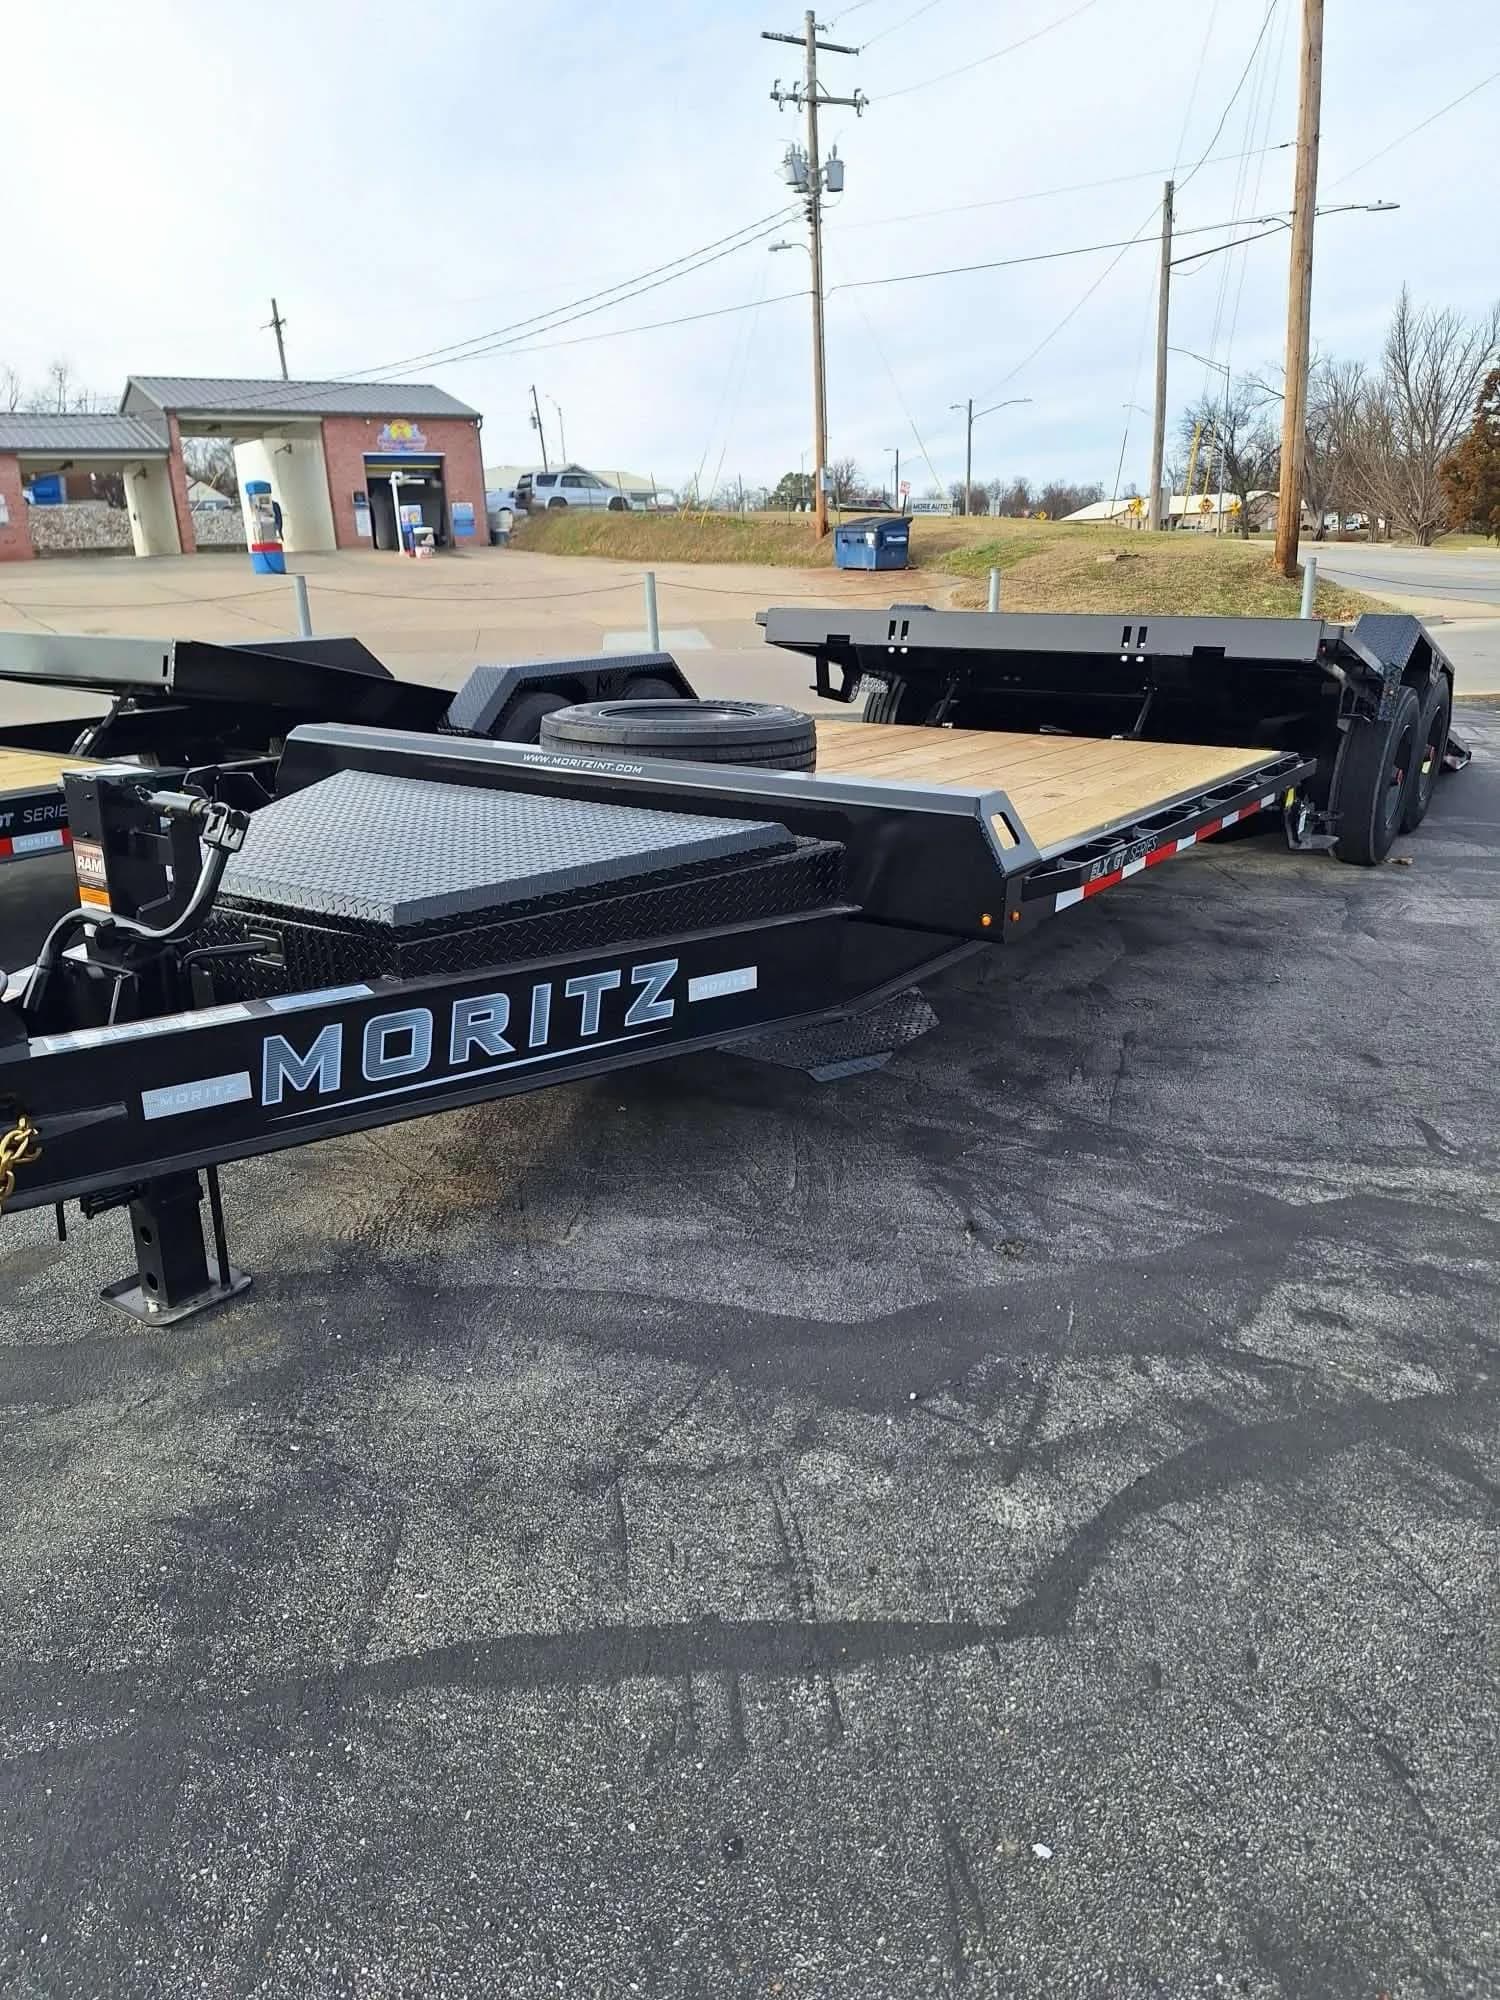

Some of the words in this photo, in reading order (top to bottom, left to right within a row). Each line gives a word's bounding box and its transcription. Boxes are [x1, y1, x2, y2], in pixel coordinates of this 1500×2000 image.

[523, 753, 643, 774] WWW.MORITZINT.COM
[23, 804, 69, 823] SERIE
[76, 855, 102, 873] RAM
[1113, 851, 1127, 870] GT
[1129, 836, 1159, 862] SERIES
[261, 958, 679, 1107] MORITZ
[159, 1083, 235, 1106] MORITZ
